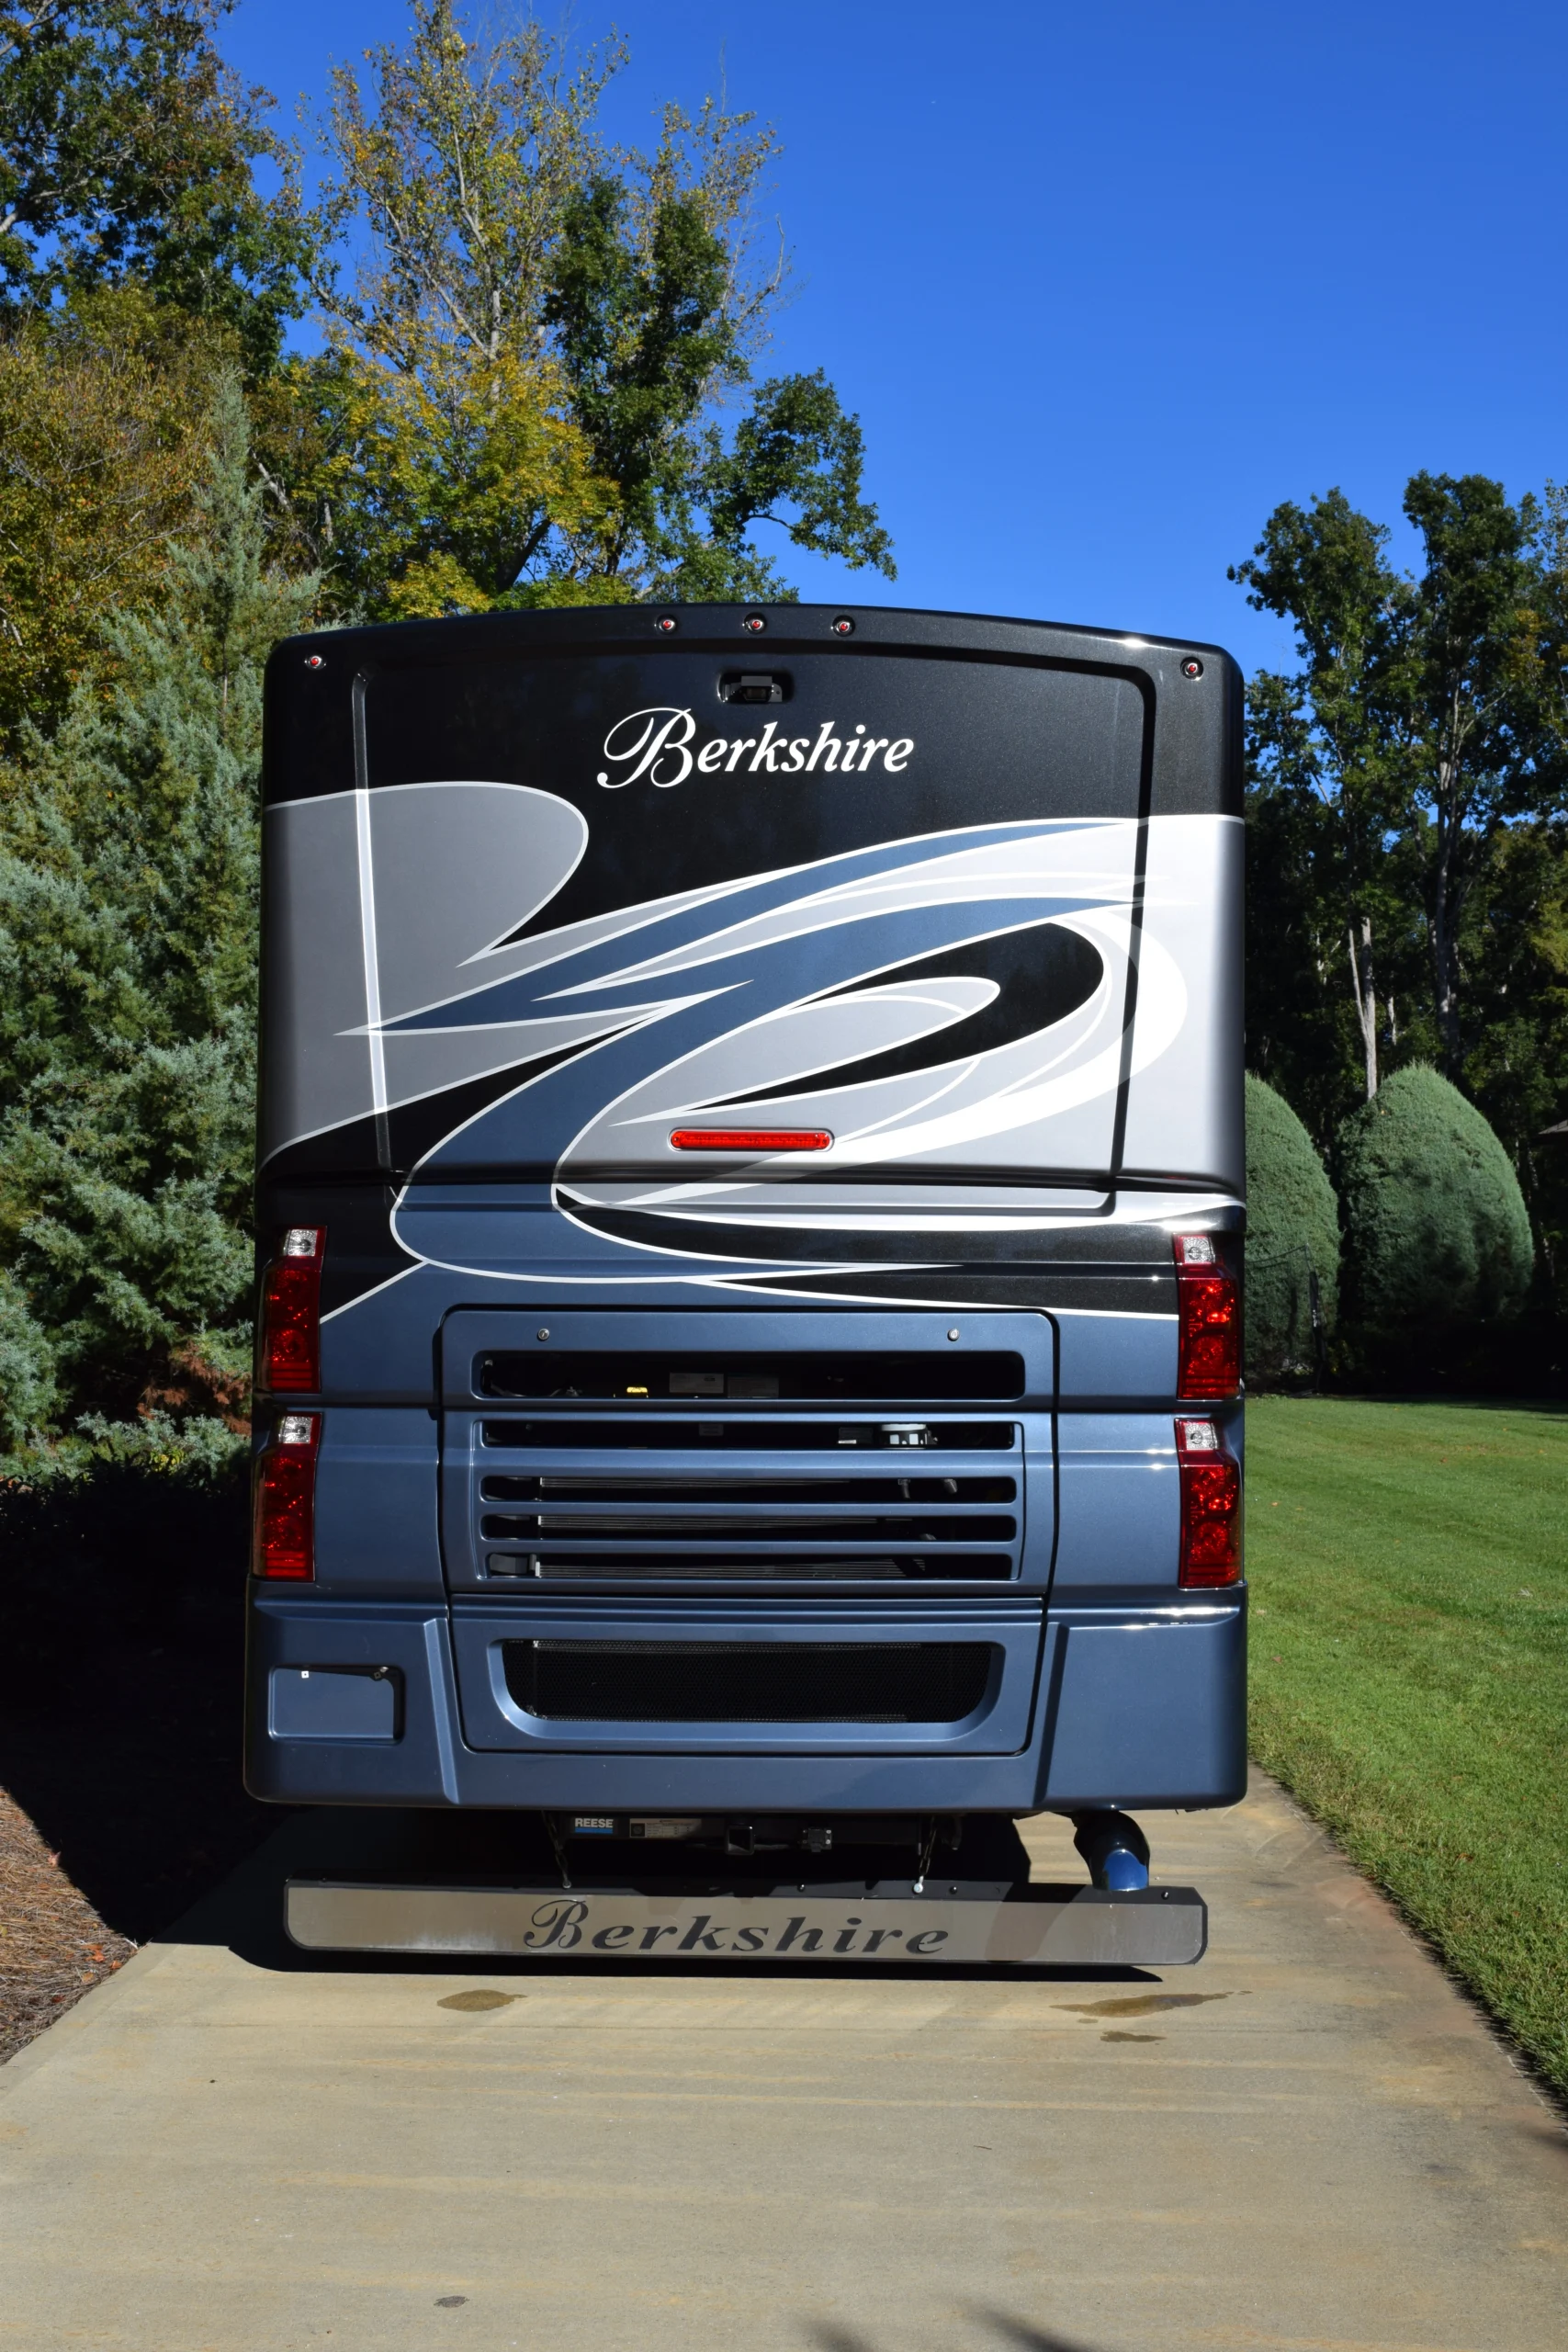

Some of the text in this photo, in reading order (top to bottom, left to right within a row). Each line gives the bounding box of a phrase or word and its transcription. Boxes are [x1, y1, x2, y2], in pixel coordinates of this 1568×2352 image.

[597, 707, 915, 789] Berkshire
[575, 1818, 614, 1827] REESE
[523, 1899, 949, 1955] Berkshire
